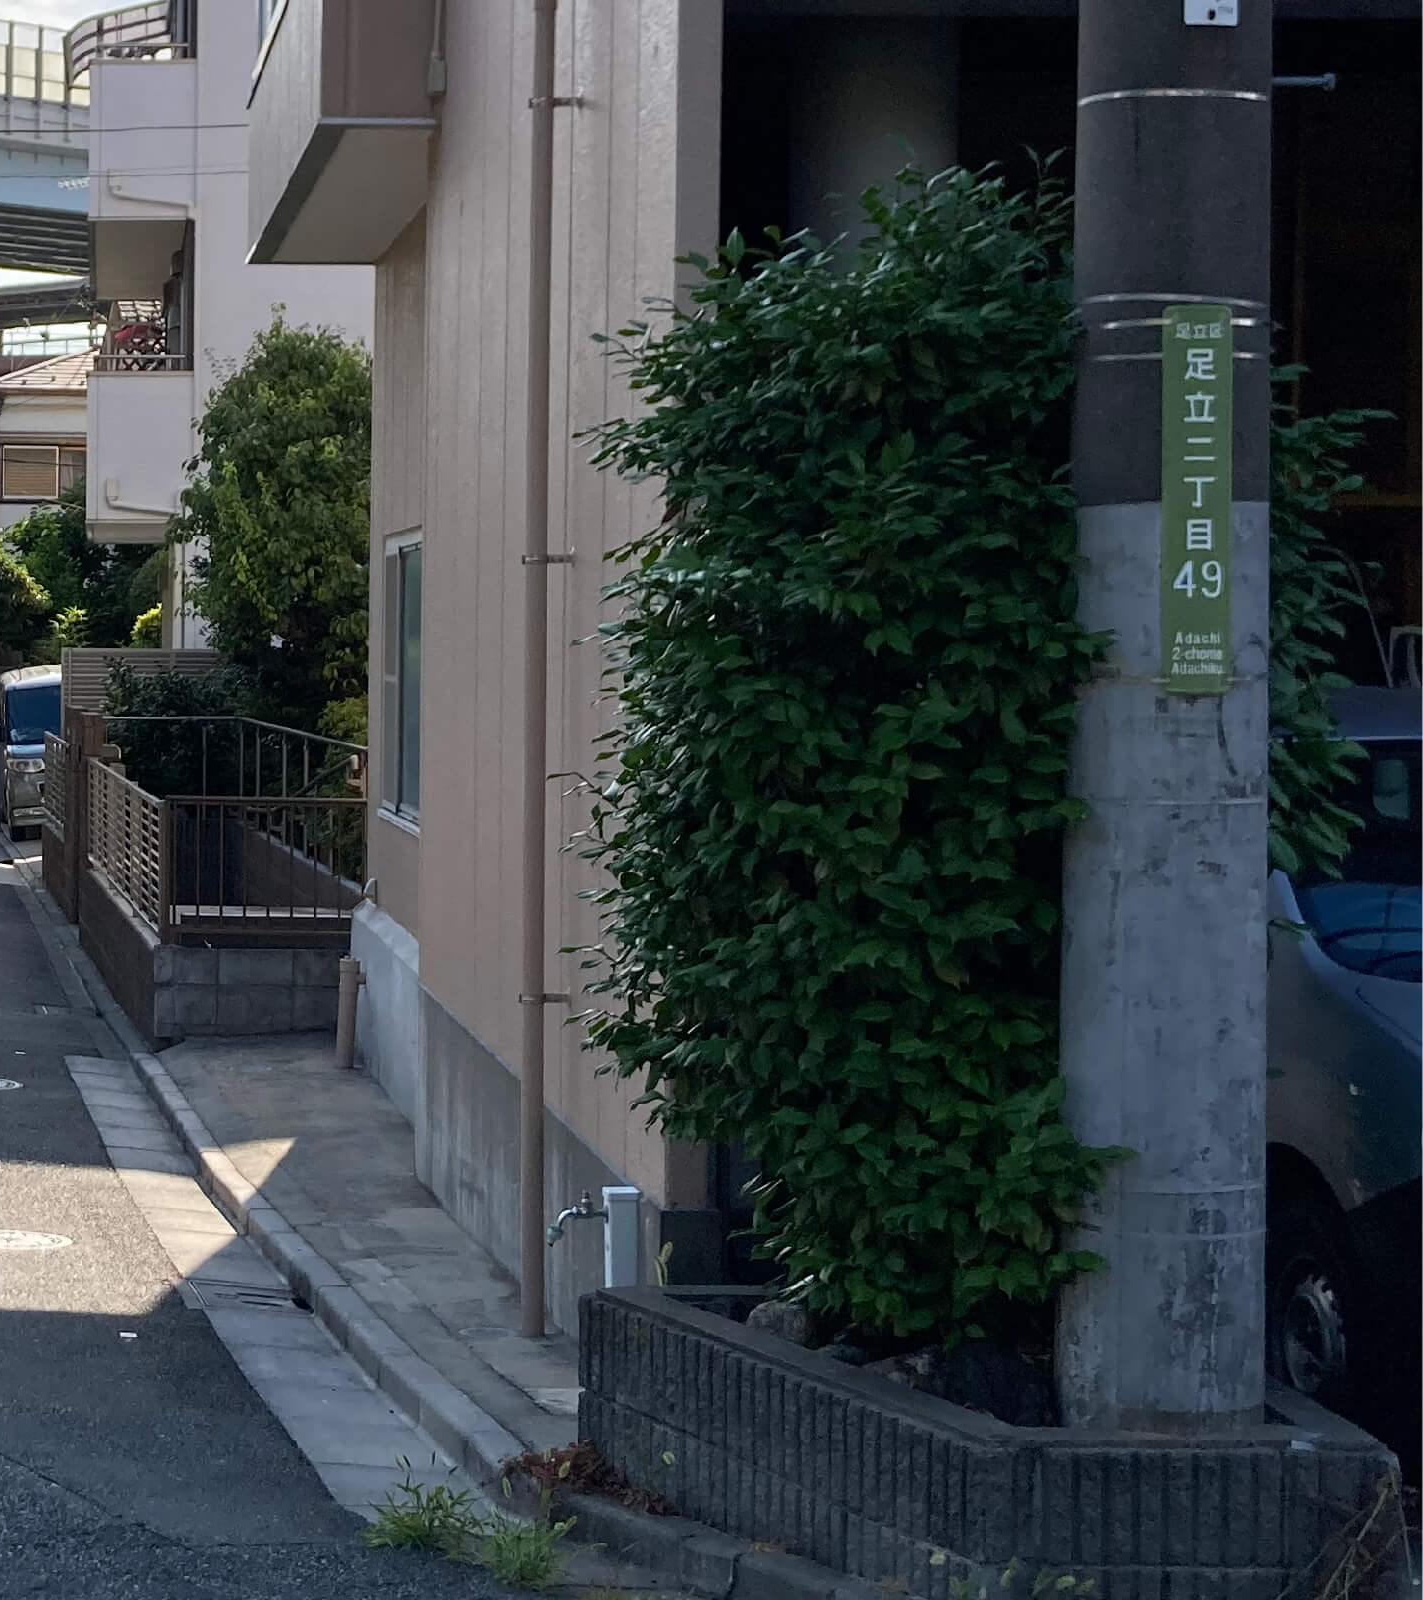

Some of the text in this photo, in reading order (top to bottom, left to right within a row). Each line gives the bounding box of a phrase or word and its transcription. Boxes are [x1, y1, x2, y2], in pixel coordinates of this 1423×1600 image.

[1183, 347, 1216, 551] 足立二丁目
[1172, 559, 1224, 598] 49
[1174, 631, 1221, 645] Adachi
[1171, 647, 1224, 661] 2-chome
